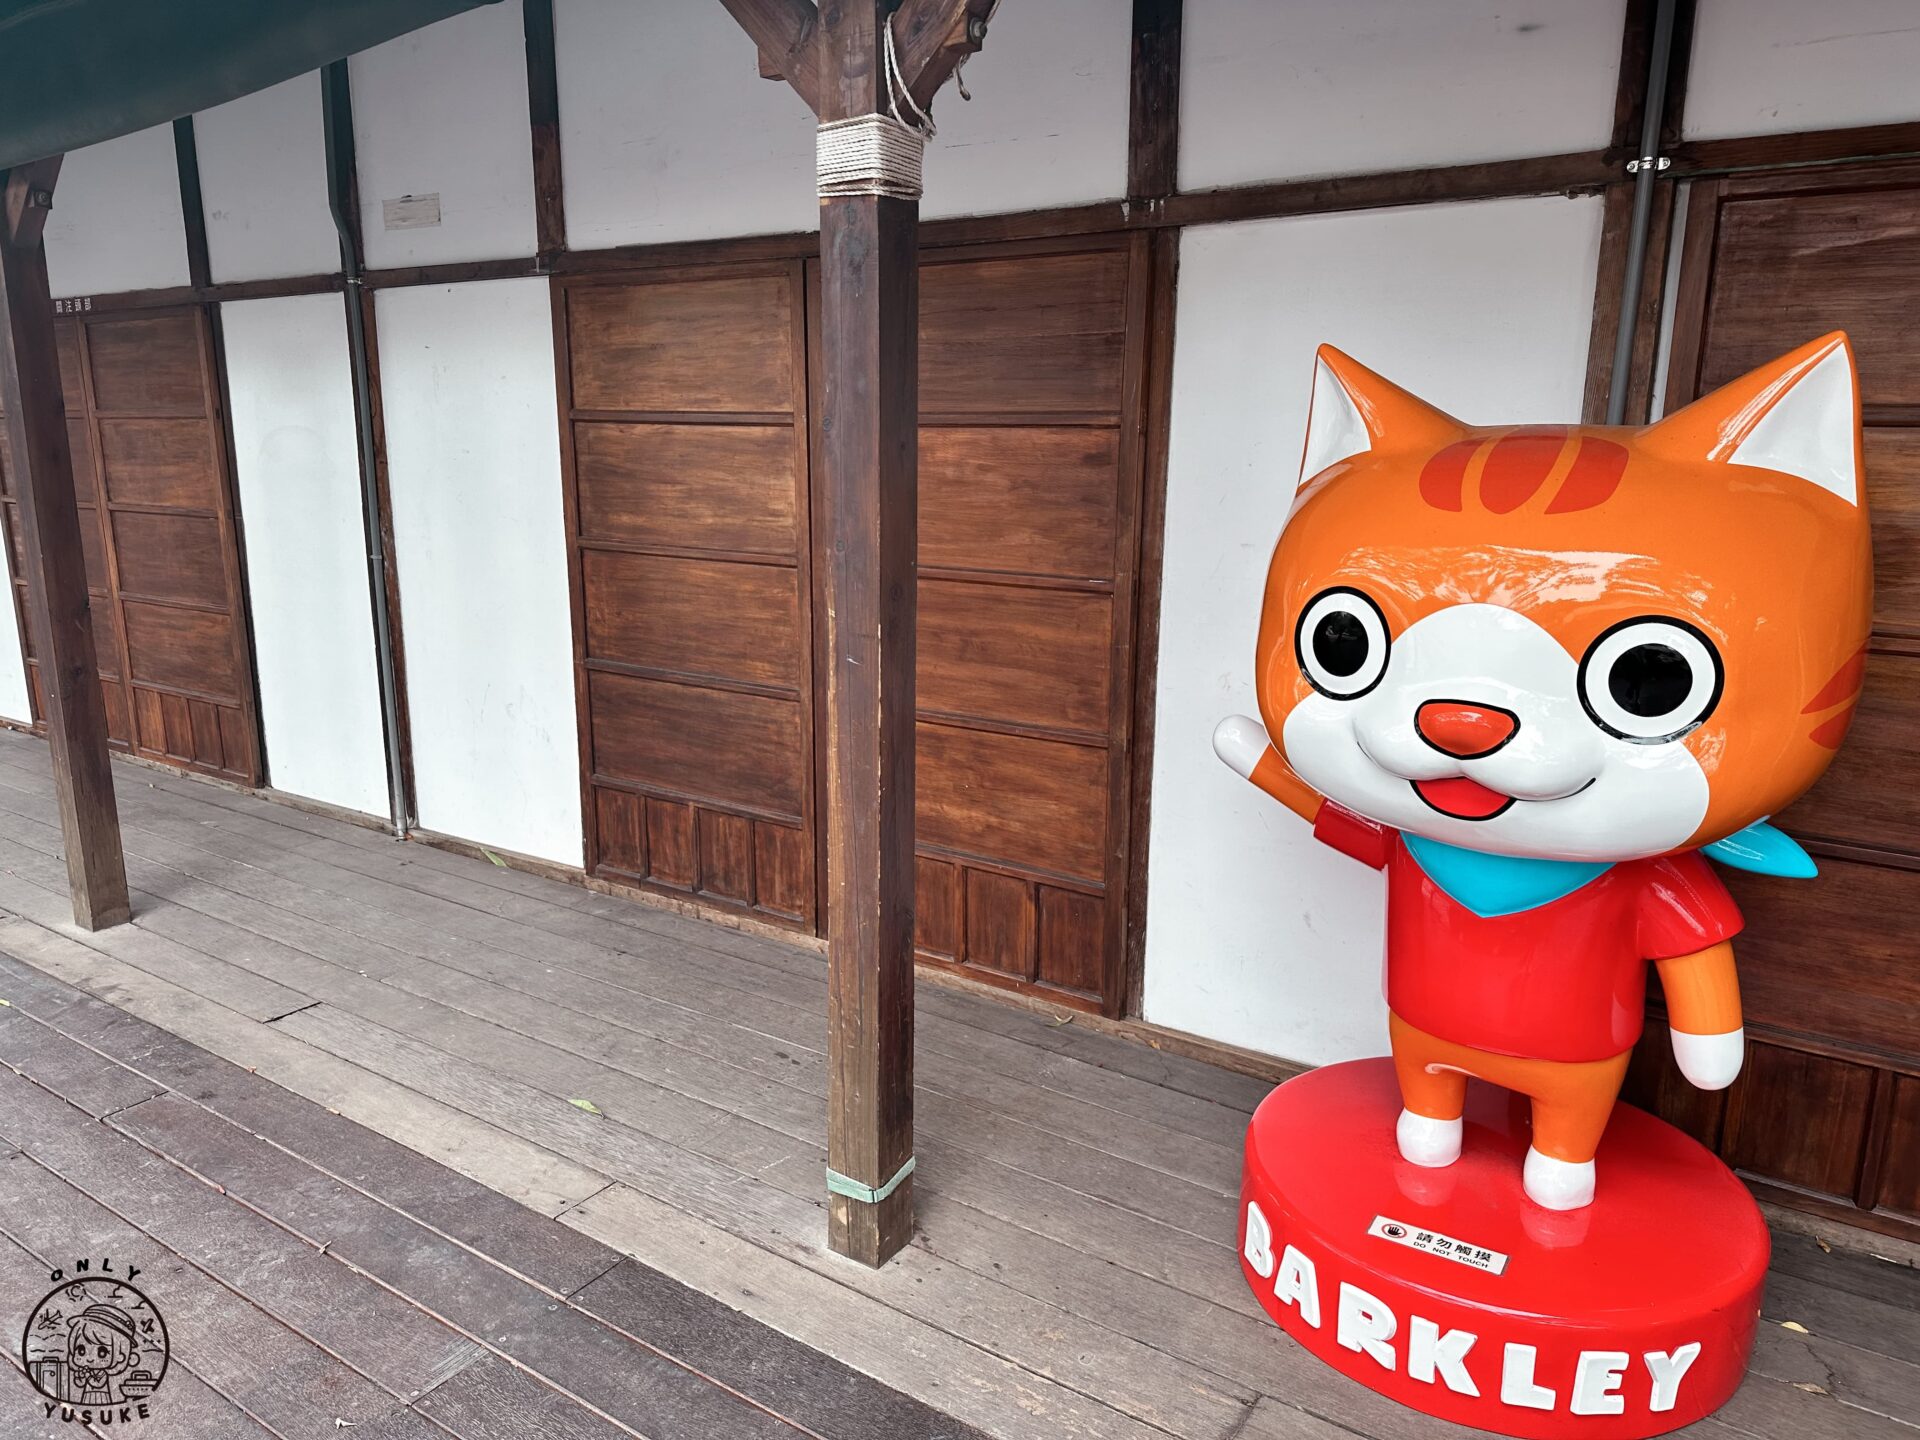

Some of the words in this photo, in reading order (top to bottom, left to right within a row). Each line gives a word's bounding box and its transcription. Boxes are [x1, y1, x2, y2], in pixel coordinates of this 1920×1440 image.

[1413, 1241, 1426, 1249] DO
[1432, 1247, 1451, 1256] NOT
[1458, 1255, 1488, 1268] TOUCH
[1416, 1232, 1492, 1262] 請勿觸摸
[1244, 1200, 1702, 1415] BARKLEY
